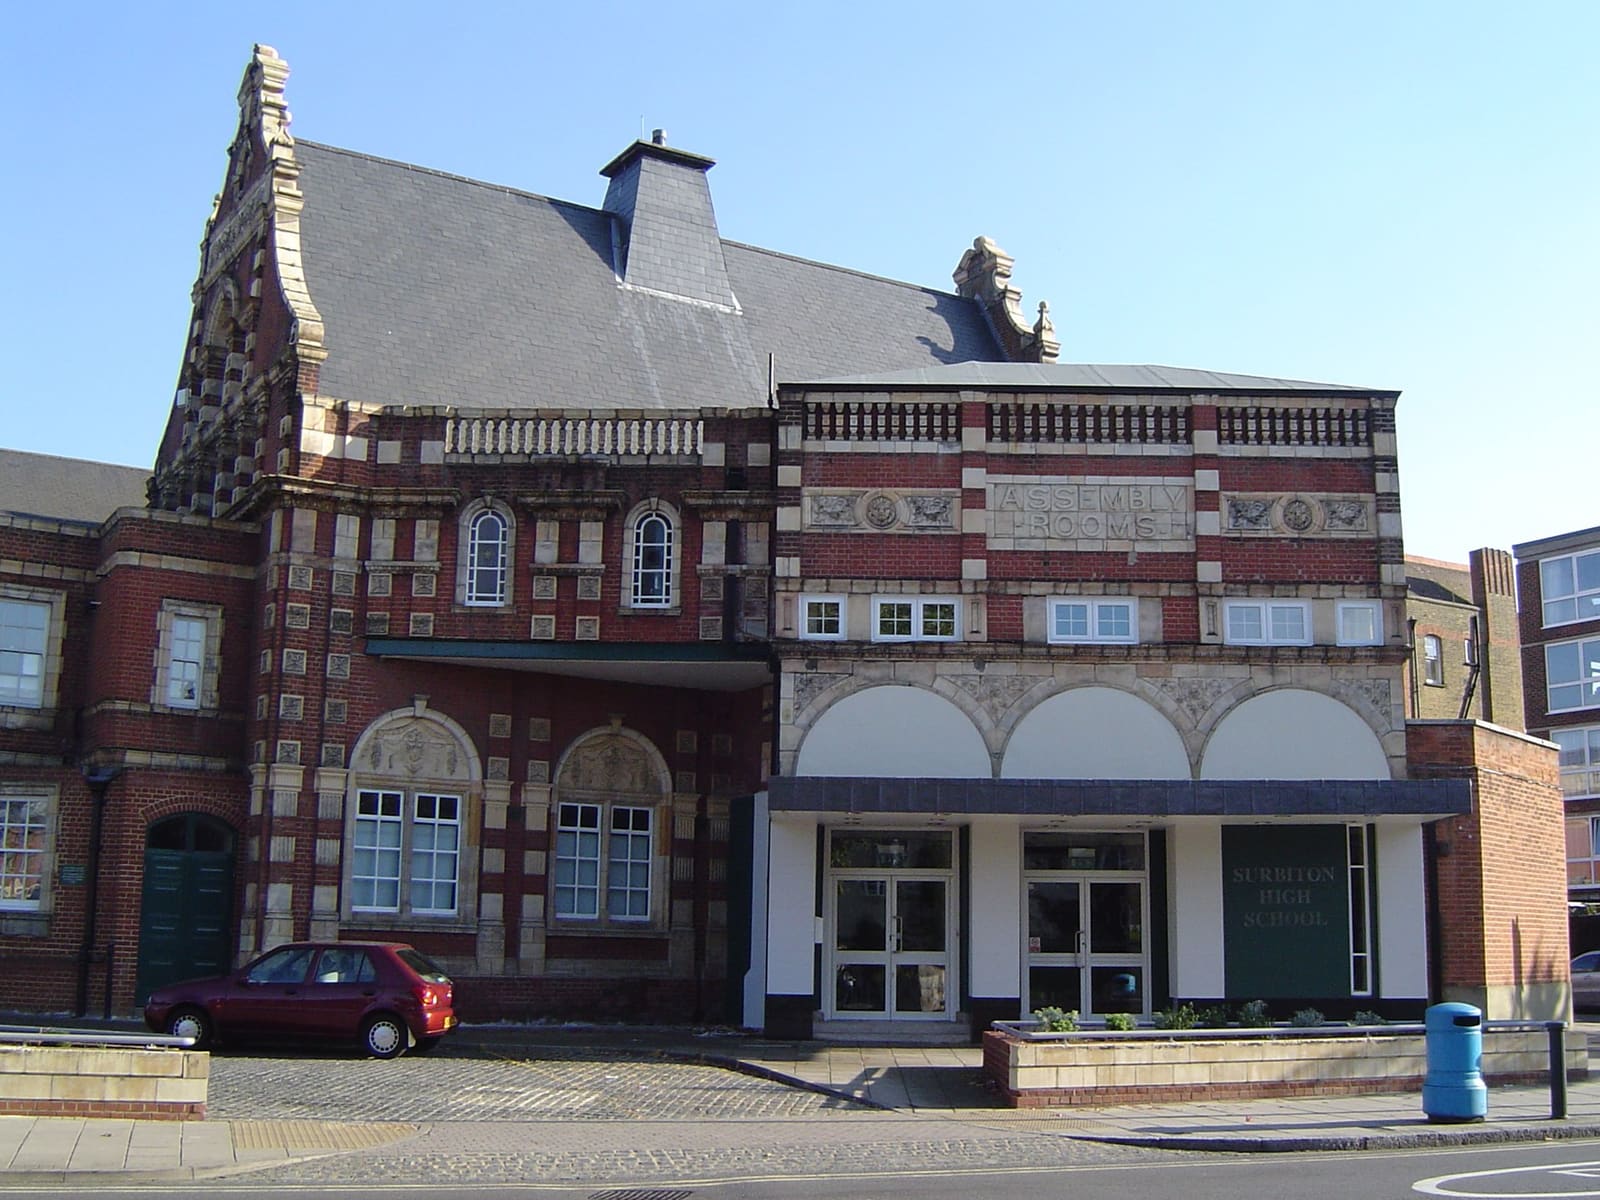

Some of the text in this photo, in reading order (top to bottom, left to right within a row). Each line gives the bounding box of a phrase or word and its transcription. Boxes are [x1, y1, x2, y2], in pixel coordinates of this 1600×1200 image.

[1000, 486, 1185, 511] ASSEMBLY
[1030, 513, 1158, 538] ROOMS
[1233, 866, 1335, 882] SURBITON
[1260, 889, 1312, 904] HIGH
[1243, 911, 1328, 927] SCHOOL
